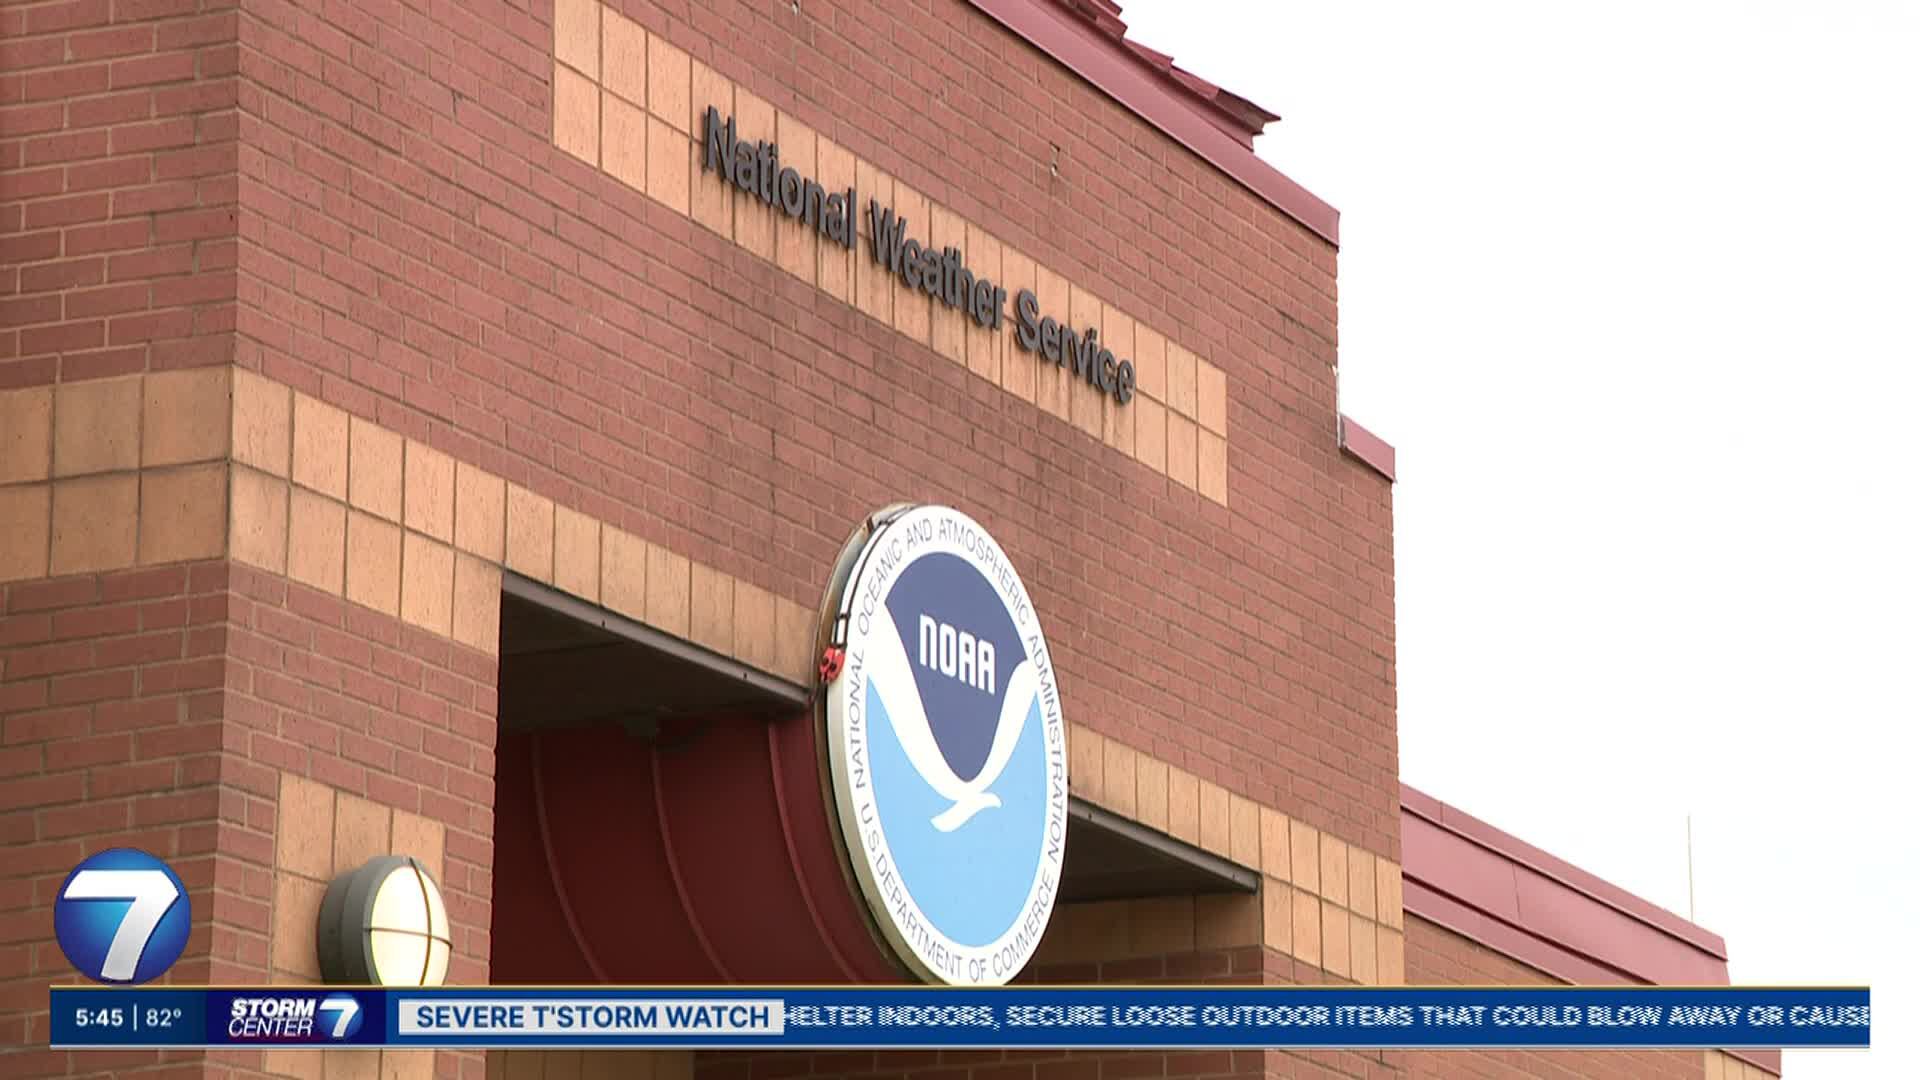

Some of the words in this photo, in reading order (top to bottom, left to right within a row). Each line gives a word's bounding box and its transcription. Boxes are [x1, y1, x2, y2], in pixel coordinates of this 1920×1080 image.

[702, 104, 857, 250] National
[867, 195, 1006, 332] Weather
[1013, 288, 1136, 405] Service
[848, 649, 866, 789] NATIONAL
[857, 539, 901, 636] OCEANIC
[905, 517, 933, 546] AND
[938, 518, 1031, 626] ATMOSPHERIC
[1027, 633, 1064, 865] ADMINISTRATION
[919, 613, 996, 696] NOAA
[968, 958, 987, 984] OF
[992, 867, 1055, 978] COMMERCE
